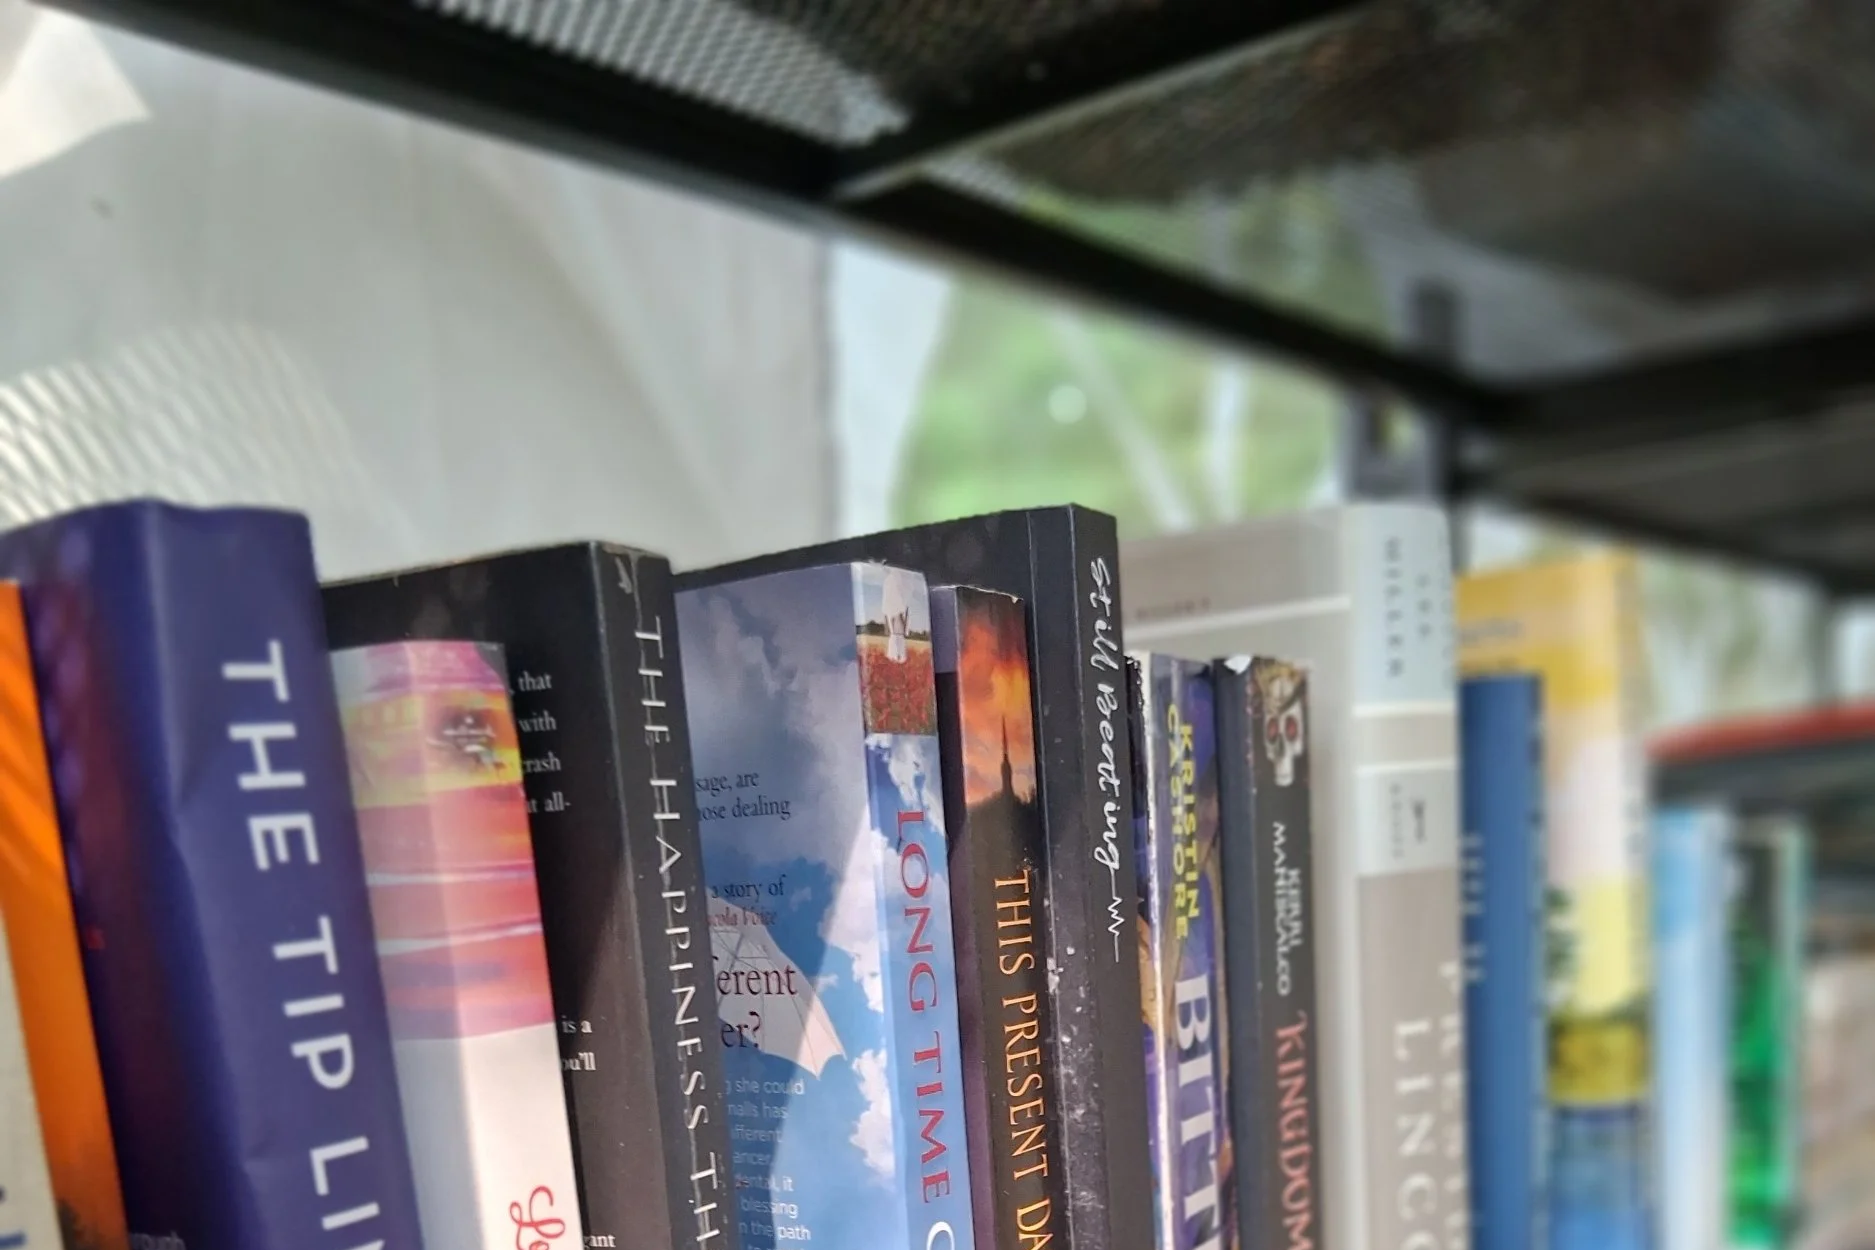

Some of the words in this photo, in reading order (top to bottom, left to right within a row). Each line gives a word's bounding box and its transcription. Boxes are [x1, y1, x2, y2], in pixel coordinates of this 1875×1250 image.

[1090, 557, 1120, 674] Still
[517, 669, 553, 692] that
[635, 615, 671, 745] THE
[518, 709, 558, 733] with
[521, 751, 562, 773] rash
[736, 772, 760, 788] are
[1094, 681, 1121, 871] Beating
[732, 795, 791, 821] dealing
[1167, 703, 1189, 940] CASHORE
[1179, 723, 1200, 919] KRISTIN
[222, 640, 320, 871] THE
[273, 915, 354, 1090] TIP
[724, 882, 763, 903] story
[768, 874, 787, 896] of
[897, 810, 939, 1012] LONG
[994, 869, 1035, 976] THIS
[650, 779, 709, 1131] HAPPINESS
[561, 1014, 577, 1034] is
[581, 1020, 593, 1033] a
[735, 1077, 760, 1094] she
[763, 1078, 806, 1096] could
[913, 1030, 950, 1203] TIME
[1002, 993, 1048, 1181] PRESENT
[740, 1196, 799, 1219] blessing
[782, 1175, 795, 1192] it
[750, 1220, 774, 1237] the
[777, 1225, 812, 1241] path
